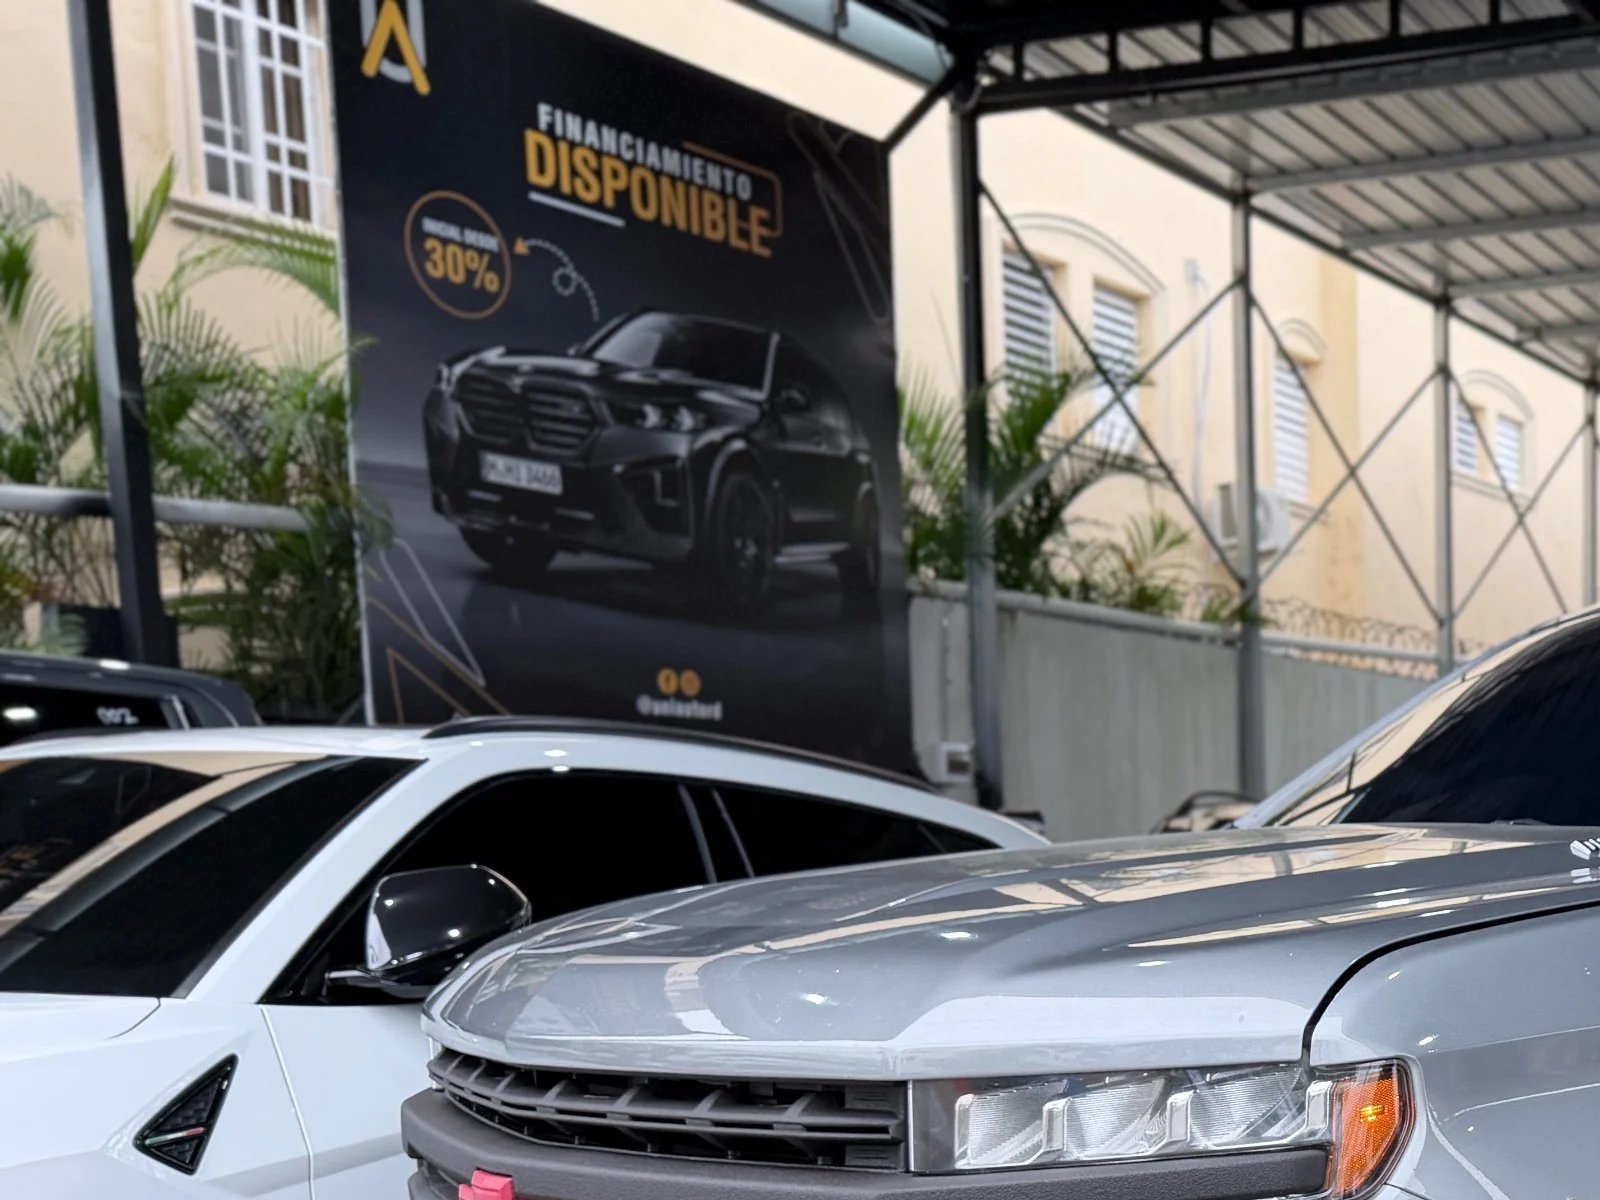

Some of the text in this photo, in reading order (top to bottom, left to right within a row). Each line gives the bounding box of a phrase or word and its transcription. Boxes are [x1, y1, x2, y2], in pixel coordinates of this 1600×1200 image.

[524, 128, 773, 258] DISPONIBLE
[537, 102, 753, 201] FINANCIAMIENTO
[423, 236, 501, 294] 30%
